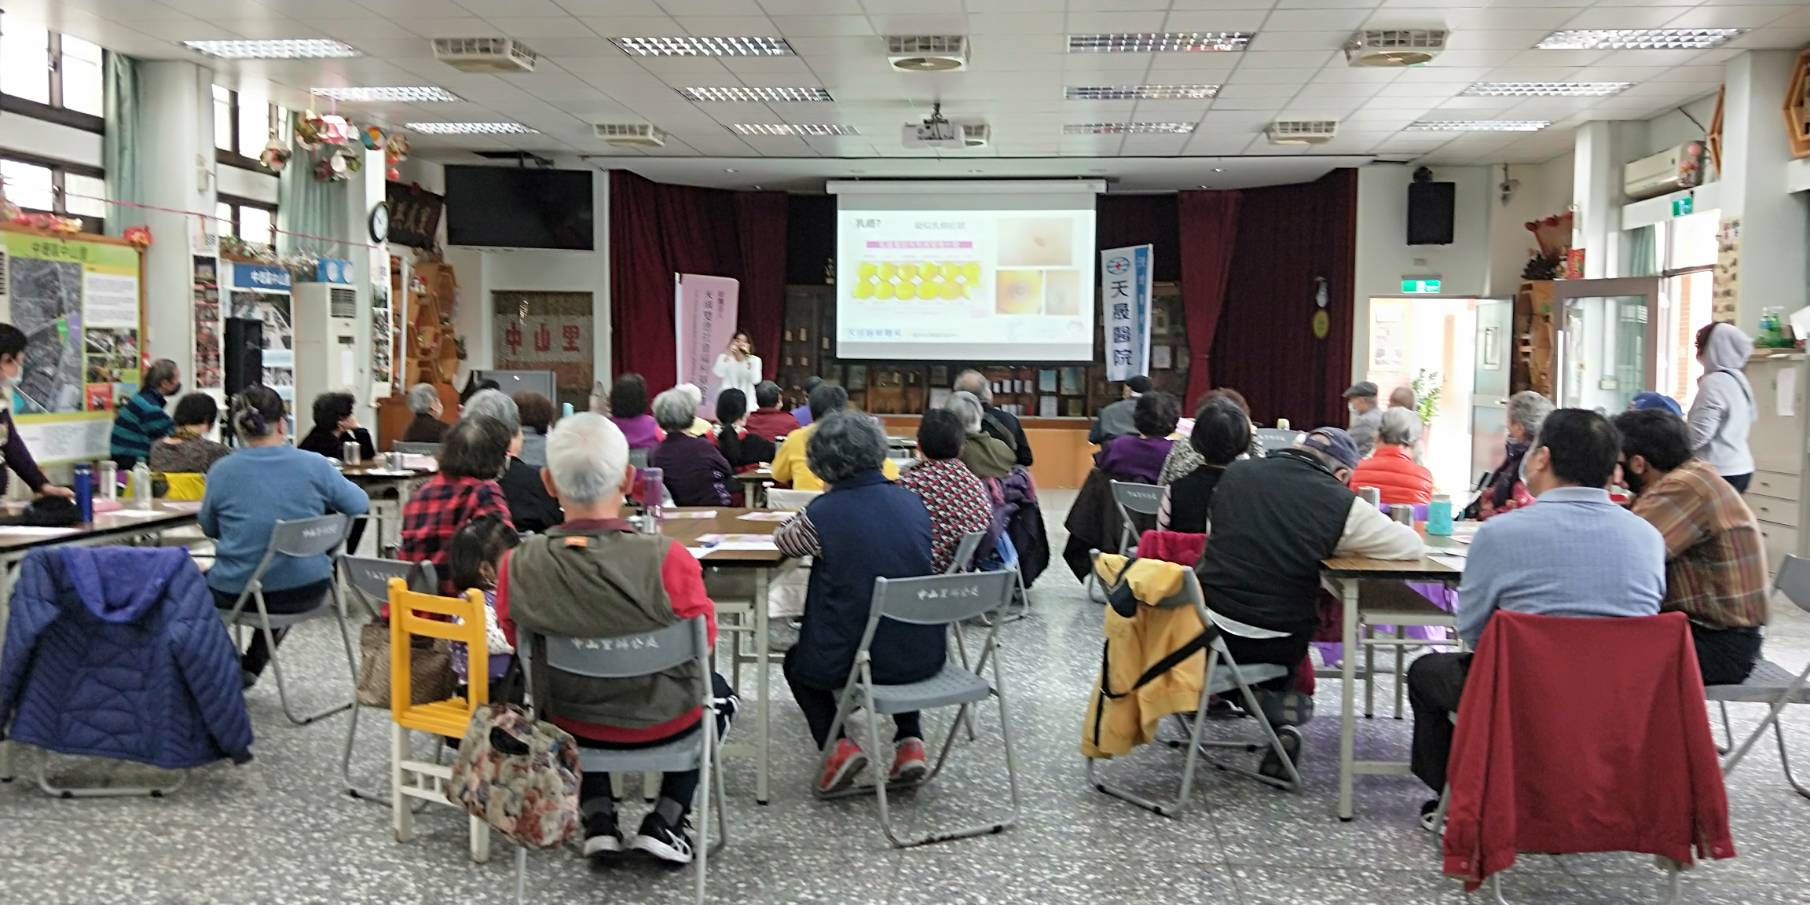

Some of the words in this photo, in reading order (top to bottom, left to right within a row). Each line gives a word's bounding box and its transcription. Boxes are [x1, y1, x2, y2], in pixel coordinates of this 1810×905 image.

[505, 321, 579, 355] 中山里
[1111, 280, 1132, 366] 天晟醫院
